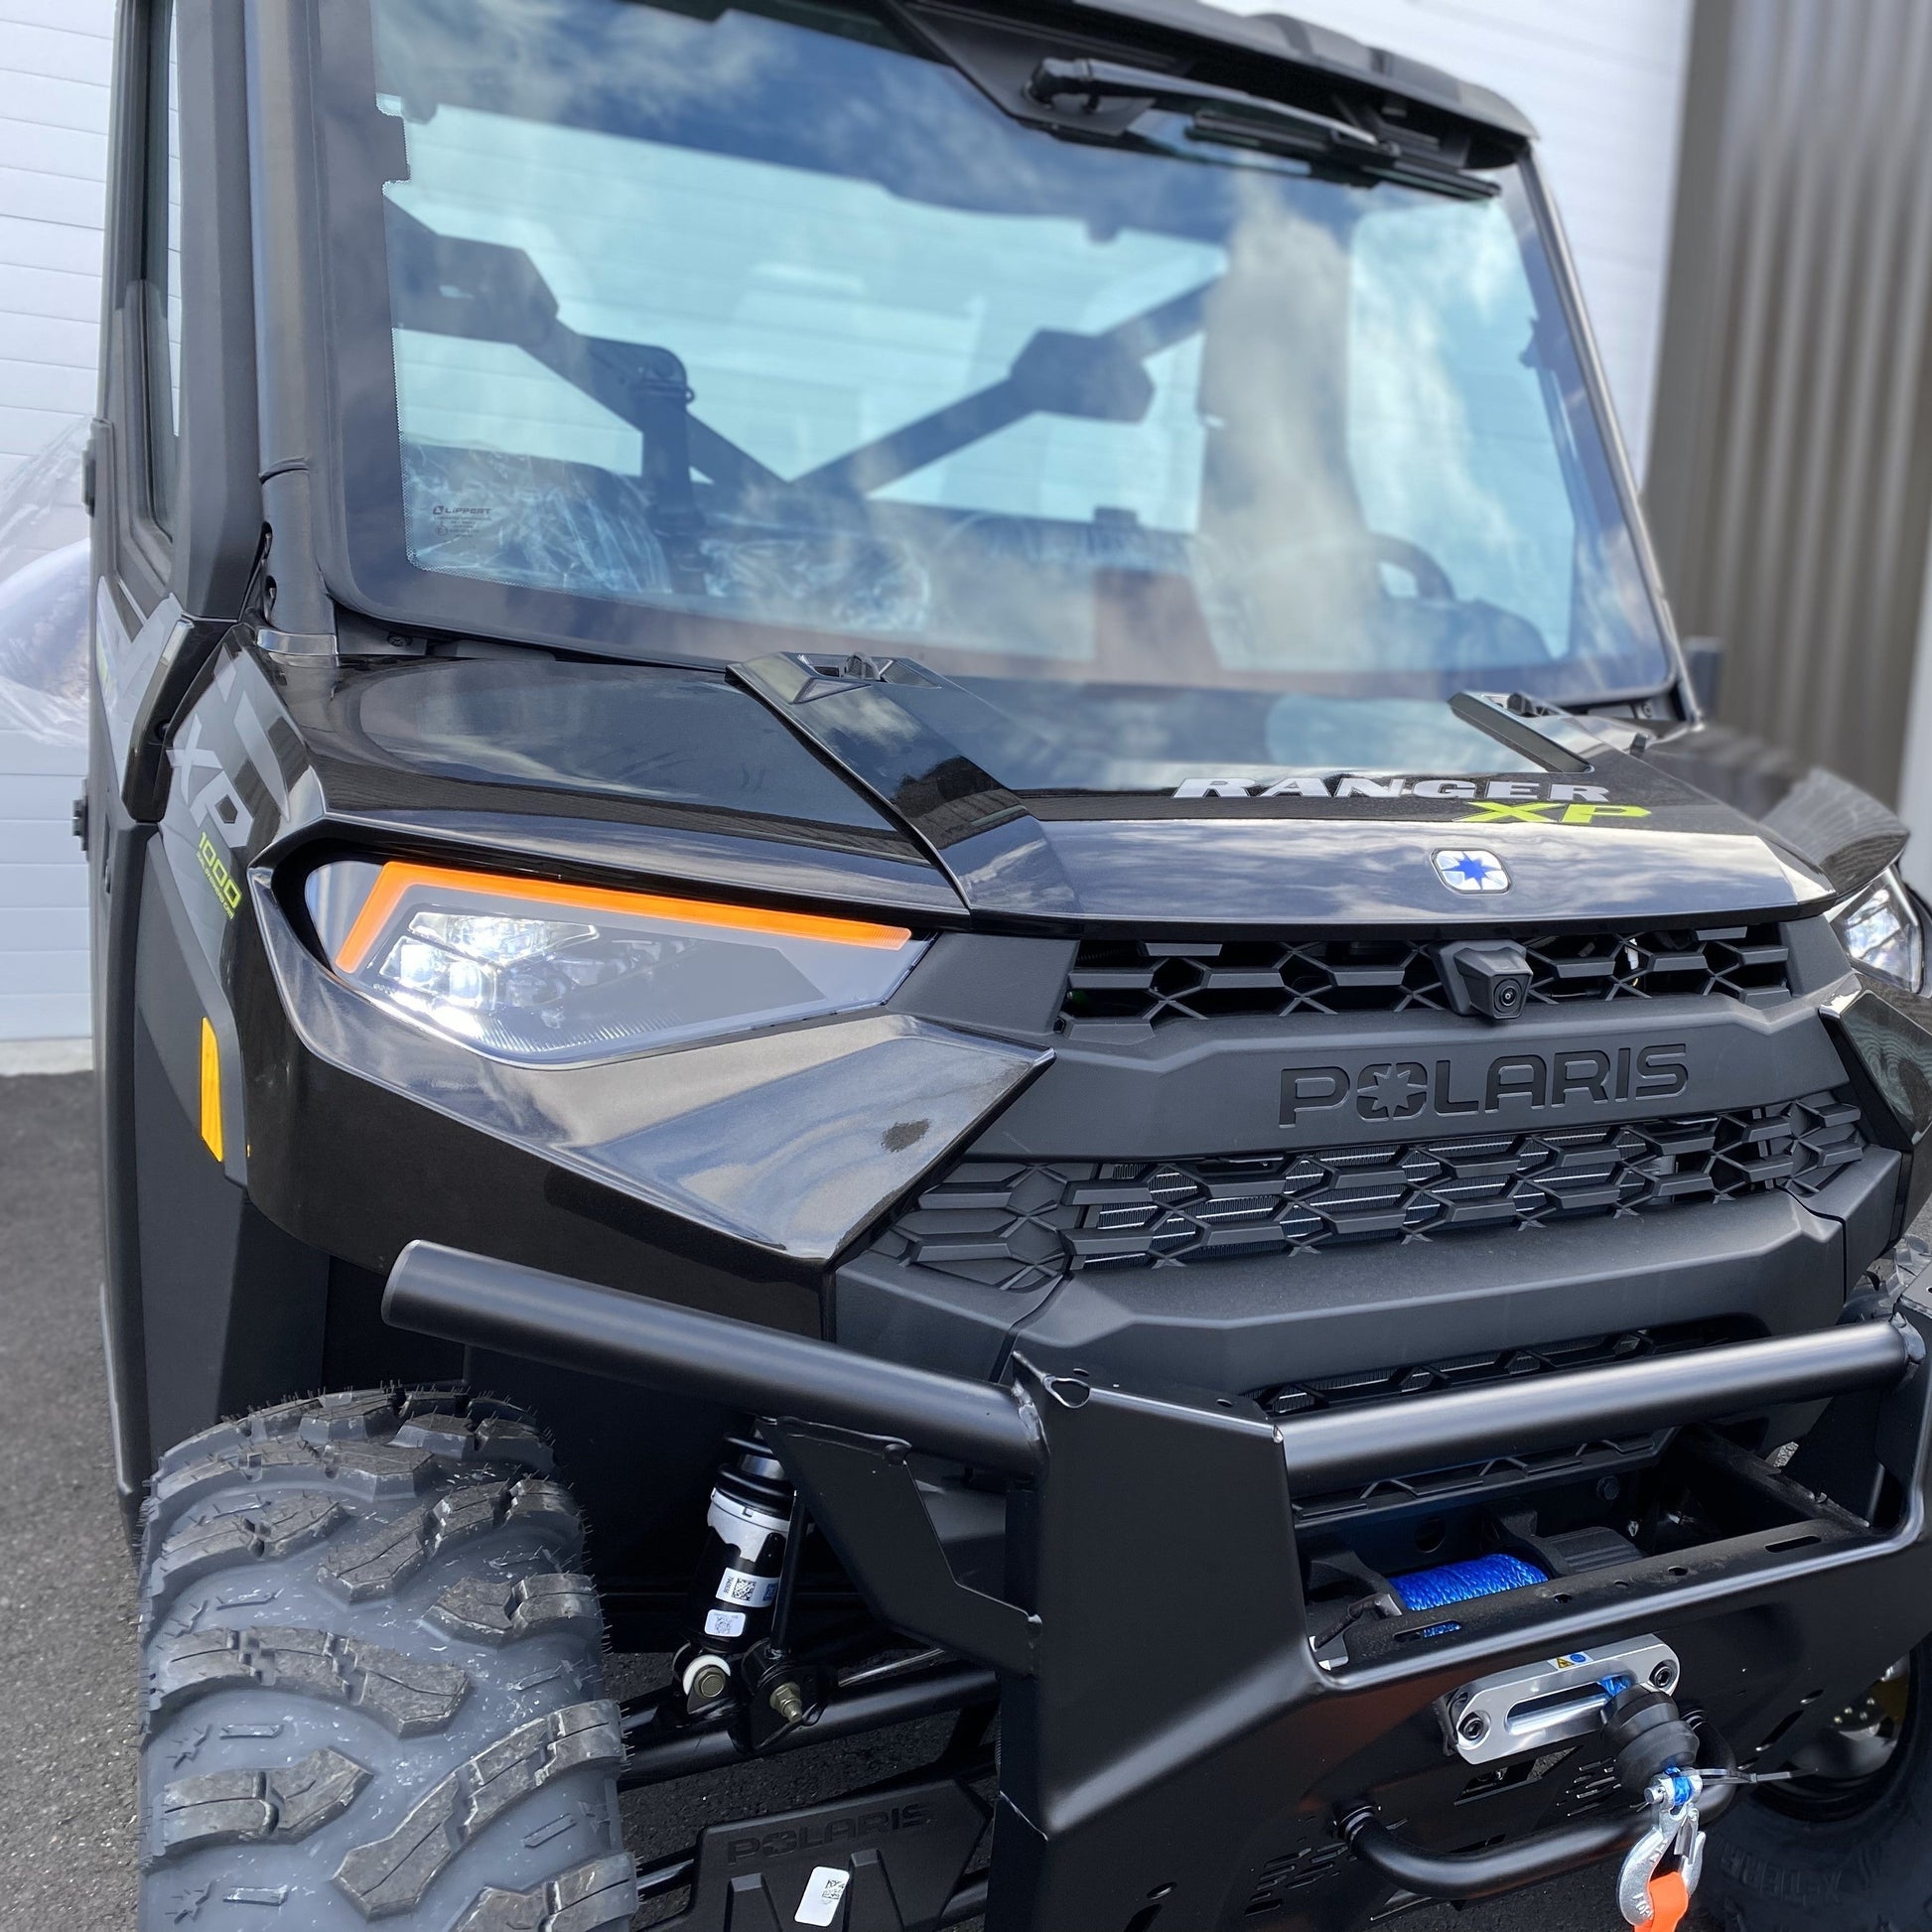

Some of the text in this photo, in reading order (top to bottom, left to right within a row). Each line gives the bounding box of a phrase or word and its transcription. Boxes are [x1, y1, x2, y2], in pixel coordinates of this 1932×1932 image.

[166, 713, 255, 849] XP
[1172, 777, 1609, 802] RANGER
[1457, 801, 1651, 824] XP
[199, 832, 241, 909] 1000
[1279, 1043, 1688, 1128] POLARIS
[728, 1803, 931, 1865] POLARIS
